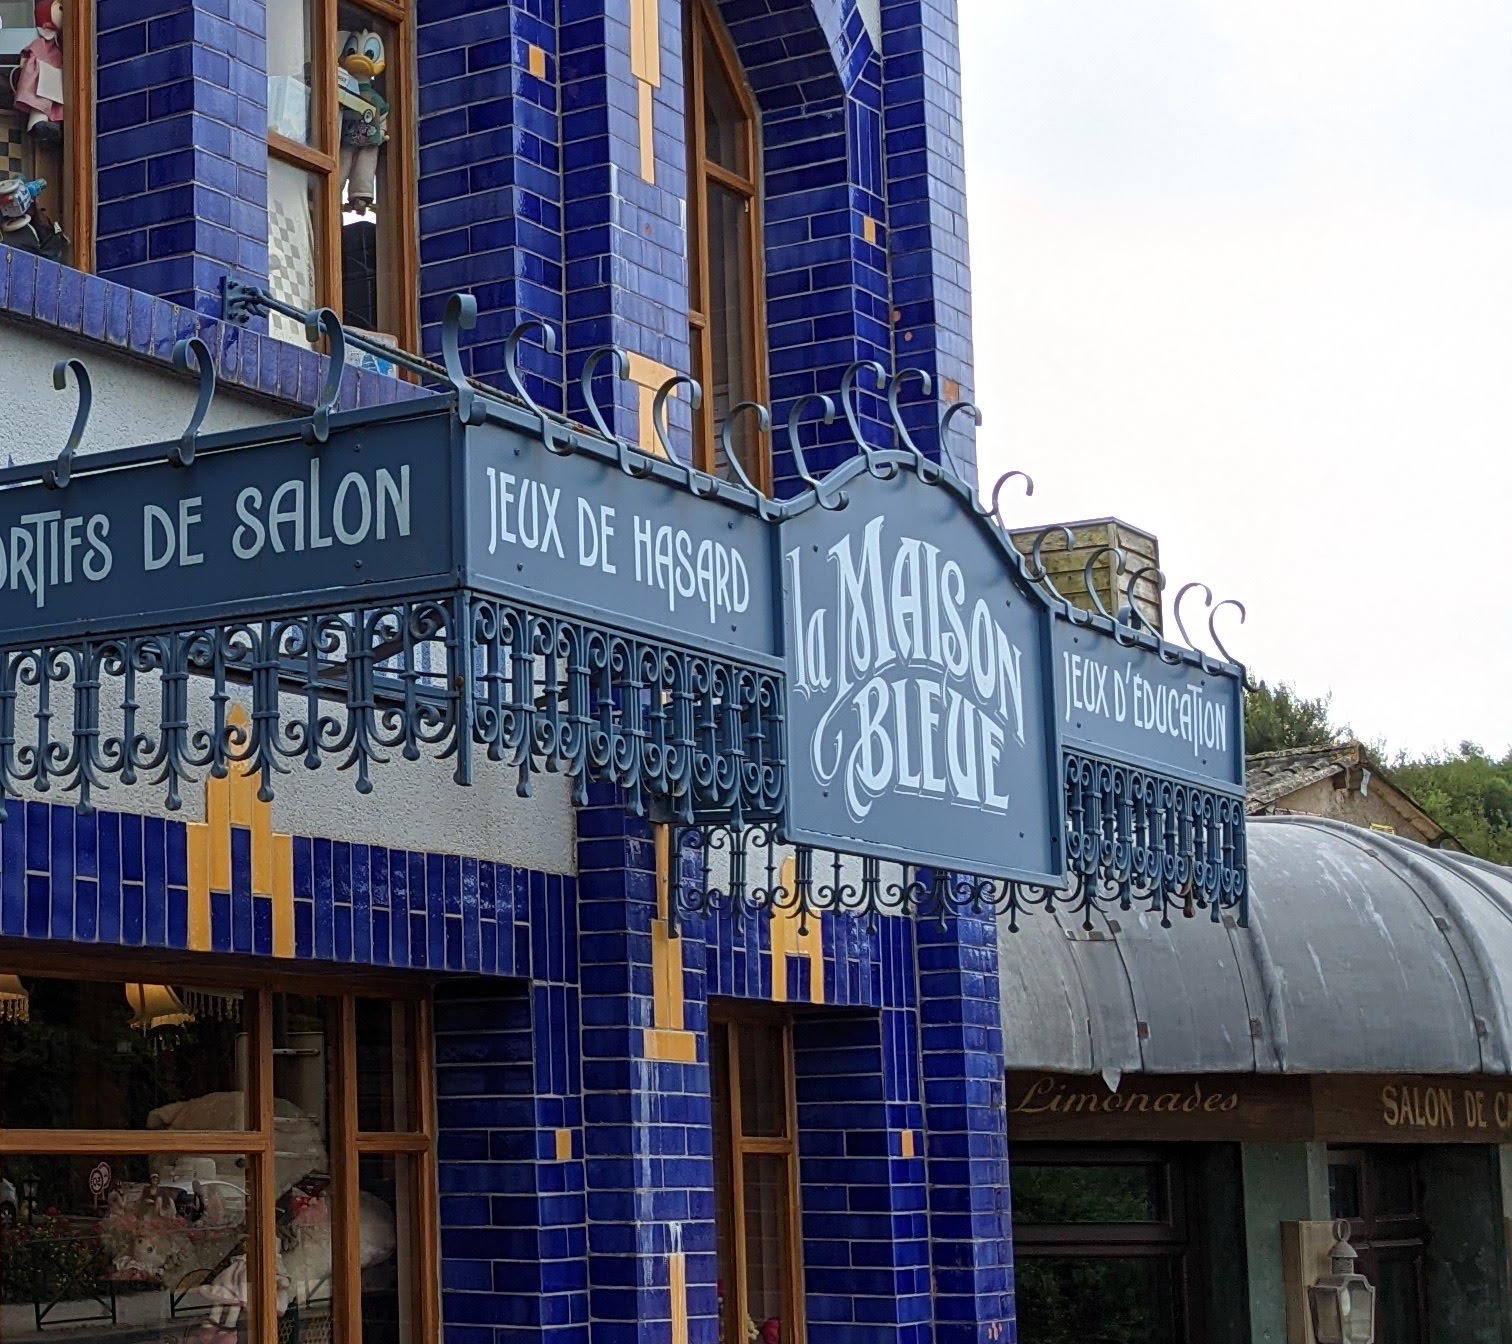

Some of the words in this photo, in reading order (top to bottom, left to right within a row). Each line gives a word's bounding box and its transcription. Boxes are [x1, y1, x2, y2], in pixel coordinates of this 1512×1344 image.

[143, 495, 203, 570] DE
[232, 458, 410, 559] SALON
[487, 467, 564, 559] JEUX
[577, 497, 616, 575] DE
[634, 516, 749, 623] HASARD
[814, 516, 1027, 782] MAISON
[1063, 651, 1109, 723] JEUX
[1114, 663, 1226, 758] D'ÉDUCATION
[844, 675, 1009, 821] BLEUE
[1013, 1076, 1237, 1112] Limonades
[1382, 1086, 1454, 1127] SALON
[1465, 1090, 1487, 1127] DE
